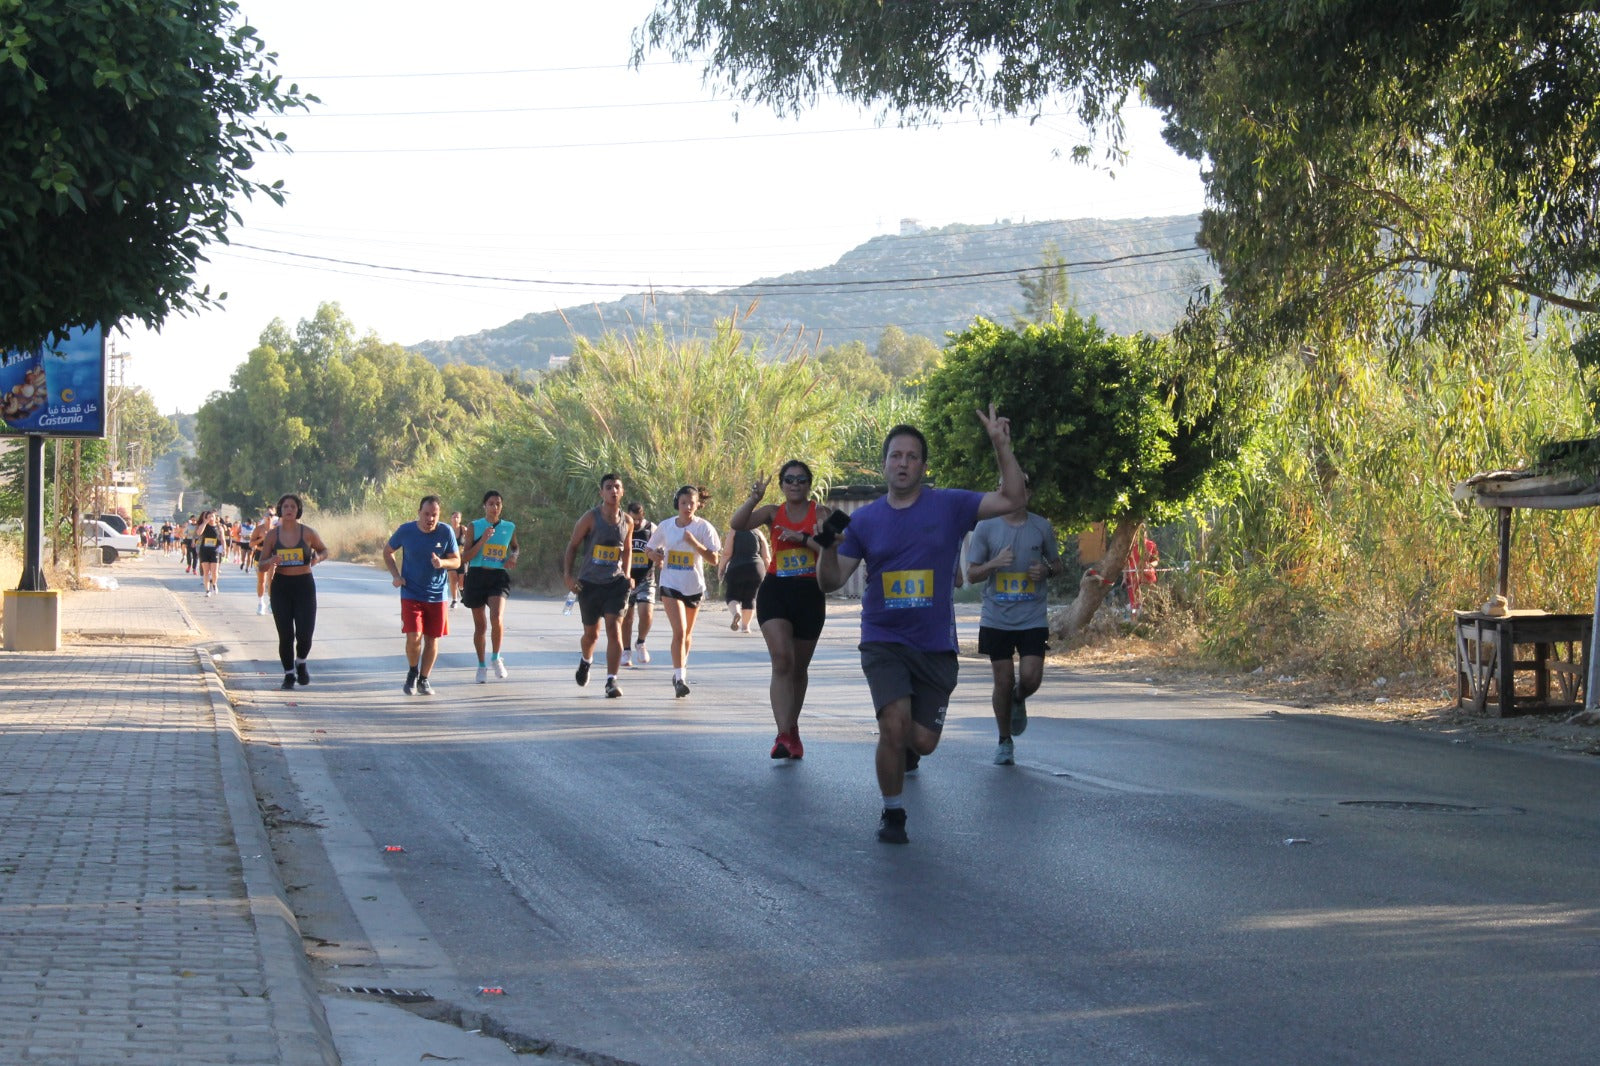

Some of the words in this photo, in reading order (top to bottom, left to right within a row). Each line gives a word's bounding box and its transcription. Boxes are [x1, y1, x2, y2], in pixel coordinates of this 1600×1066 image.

[61, 403, 82, 414] قعدة
[83, 403, 97, 414] كل
[39, 413, 83, 427] Castania
[486, 548, 503, 557] 350
[598, 550, 615, 559] 150
[783, 554, 808, 568] 359
[890, 578, 926, 595] 481
[1003, 579, 1028, 591] 189
